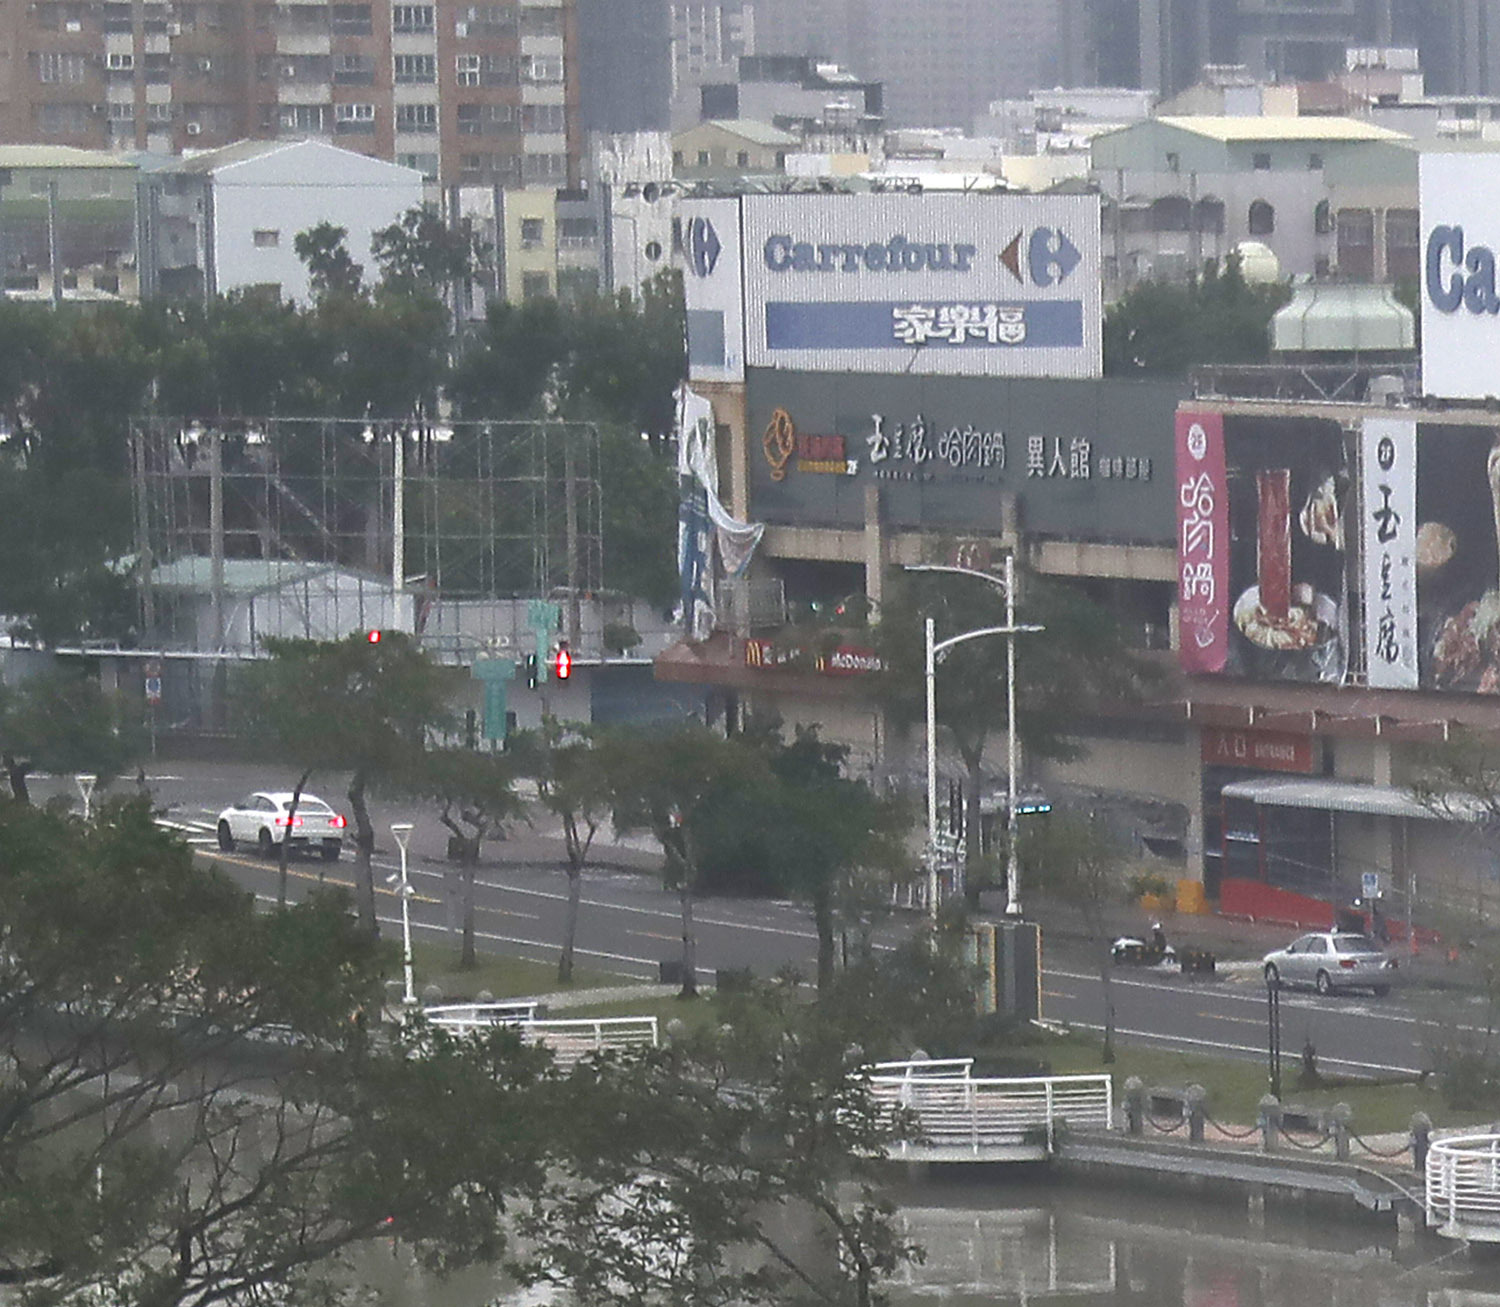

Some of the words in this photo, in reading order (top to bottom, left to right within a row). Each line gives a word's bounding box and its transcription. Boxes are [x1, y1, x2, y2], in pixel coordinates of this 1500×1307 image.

[764, 234, 977, 273] Carrefour
[892, 304, 1027, 346] 家樂福
